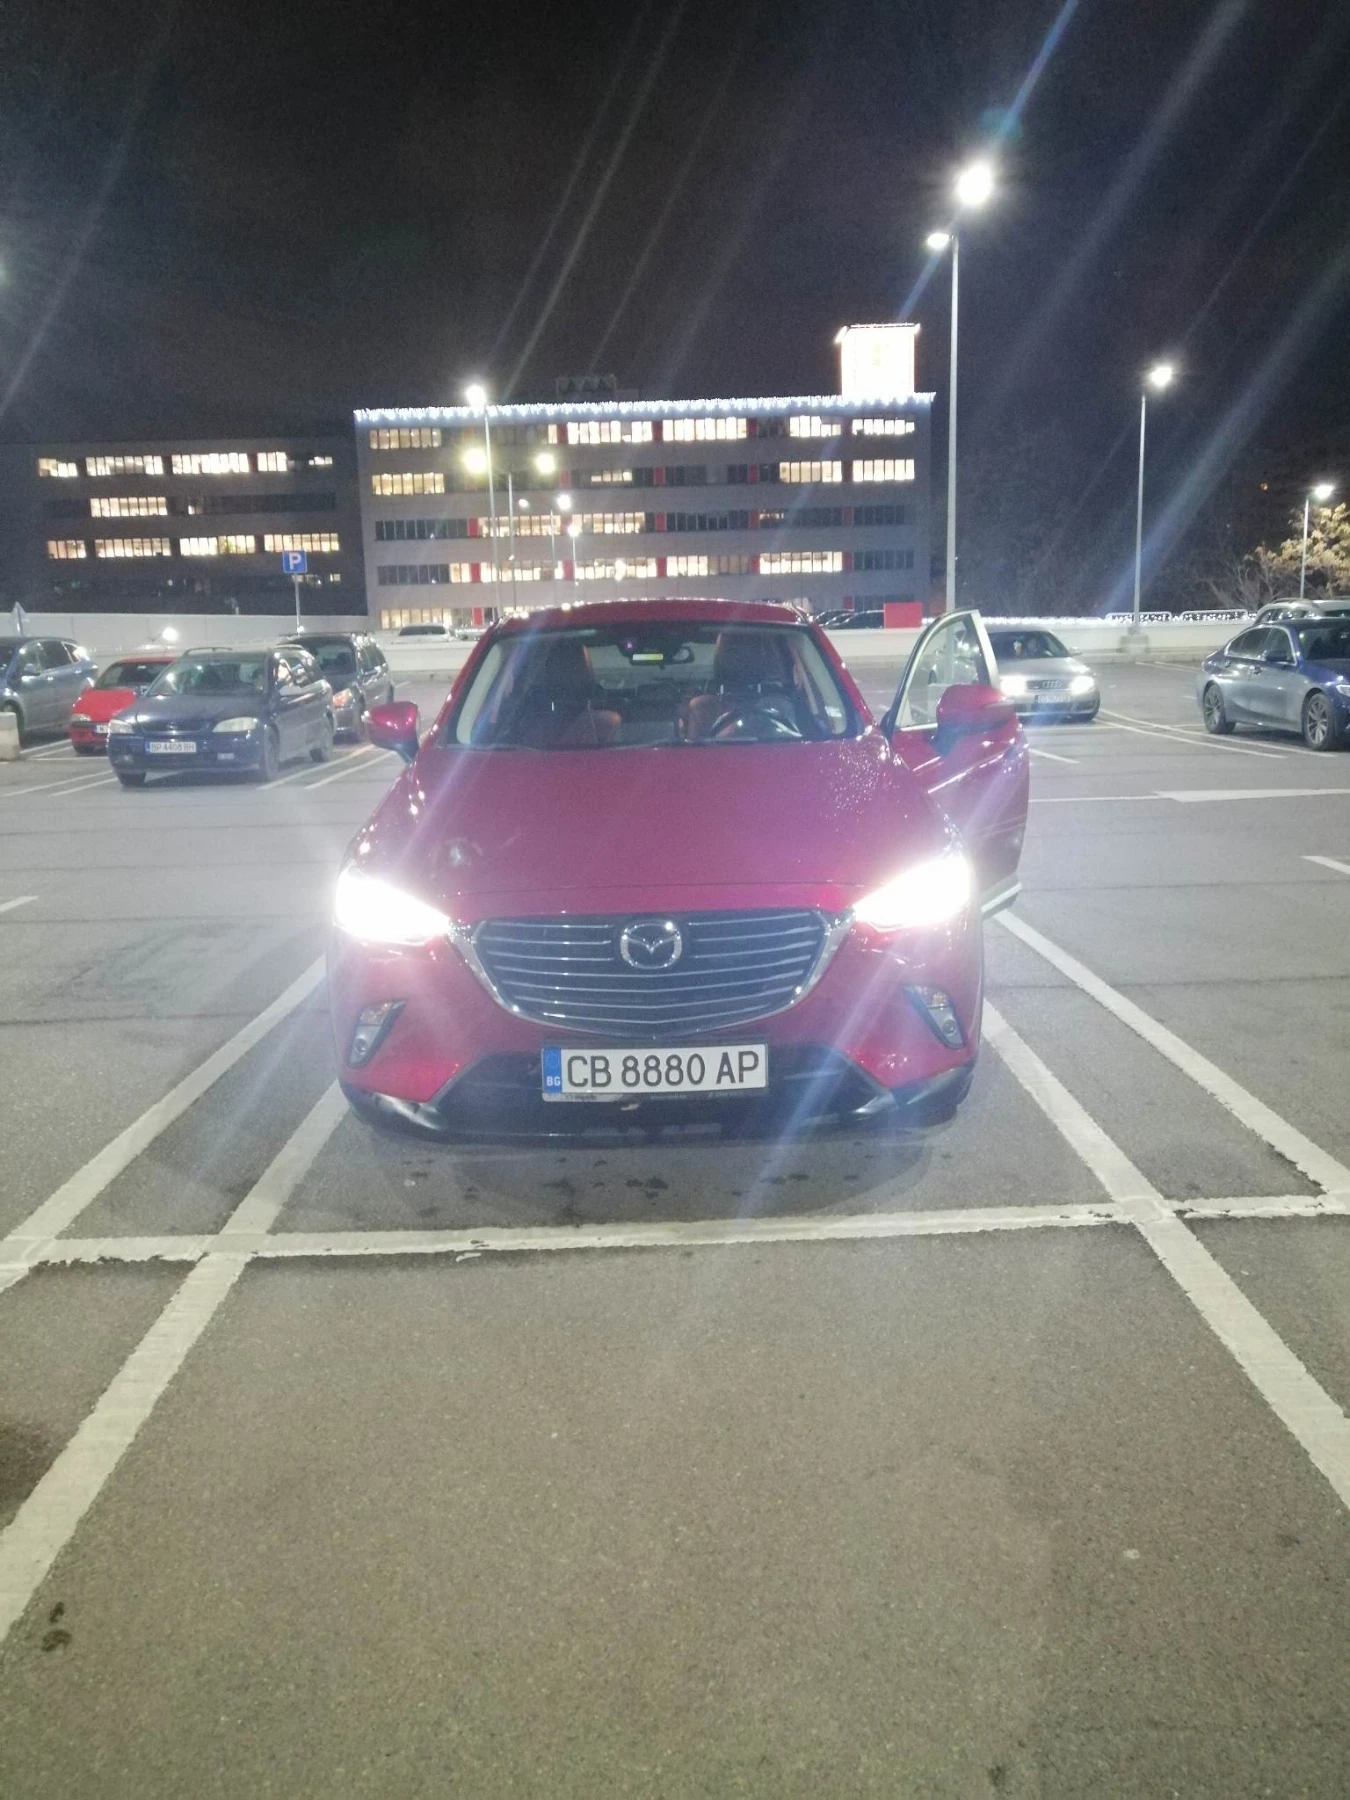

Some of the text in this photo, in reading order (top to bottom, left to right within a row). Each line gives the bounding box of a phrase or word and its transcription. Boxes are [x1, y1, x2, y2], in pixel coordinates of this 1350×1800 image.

[289, 553, 301, 570] P
[567, 1050, 759, 1087] CB 8880 AP
[546, 1075, 561, 1086] BG
